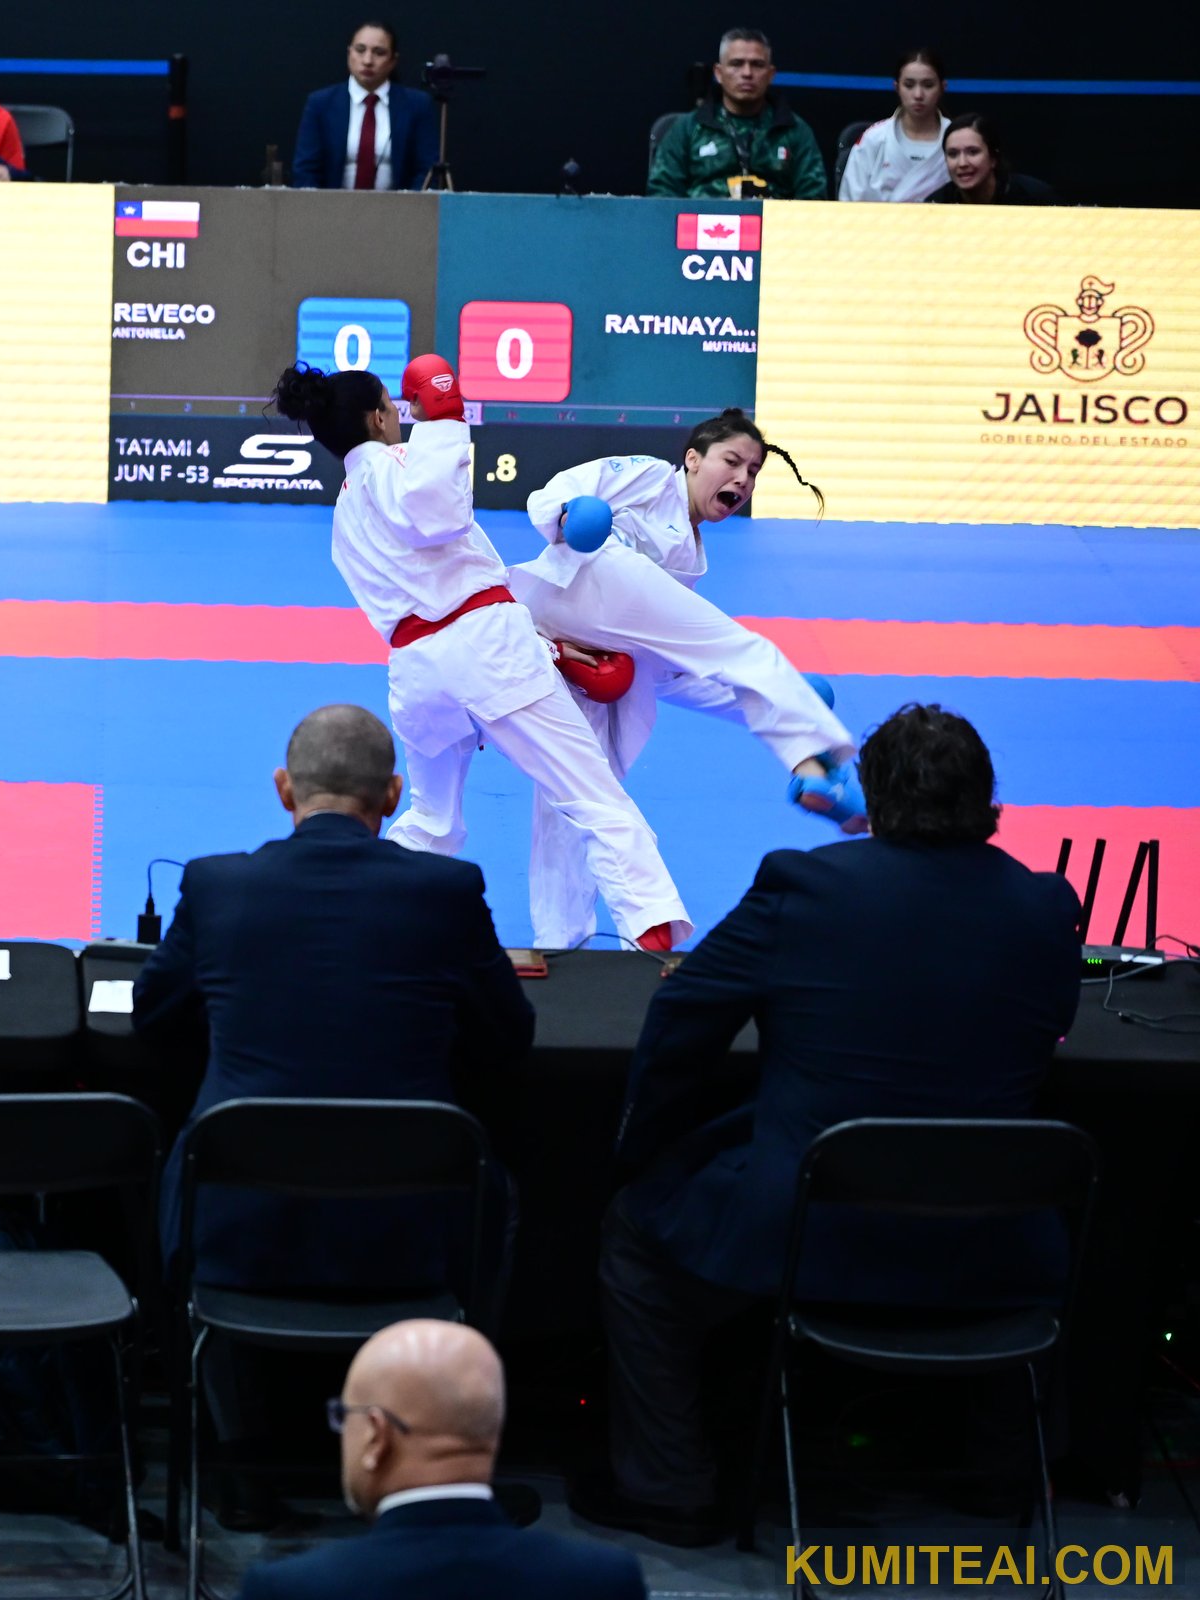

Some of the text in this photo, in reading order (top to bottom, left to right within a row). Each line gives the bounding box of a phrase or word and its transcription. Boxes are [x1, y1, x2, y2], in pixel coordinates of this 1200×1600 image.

[126, 240, 186, 269] CHI
[681, 254, 754, 282] CAN
[113, 302, 216, 325] REVECO
[605, 313, 756, 337] RATHNAYA...
[112, 327, 186, 340] ANTONELLA
[333, 324, 372, 371] 0
[495, 328, 534, 379] 0
[981, 392, 1189, 426] JALISCO
[115, 438, 210, 457] TATAMI 4
[980, 433, 1189, 449] GOBIERNO DEL ESTADO
[114, 464, 210, 484] JUN F -53
[212, 477, 324, 491] SPORTDATA
